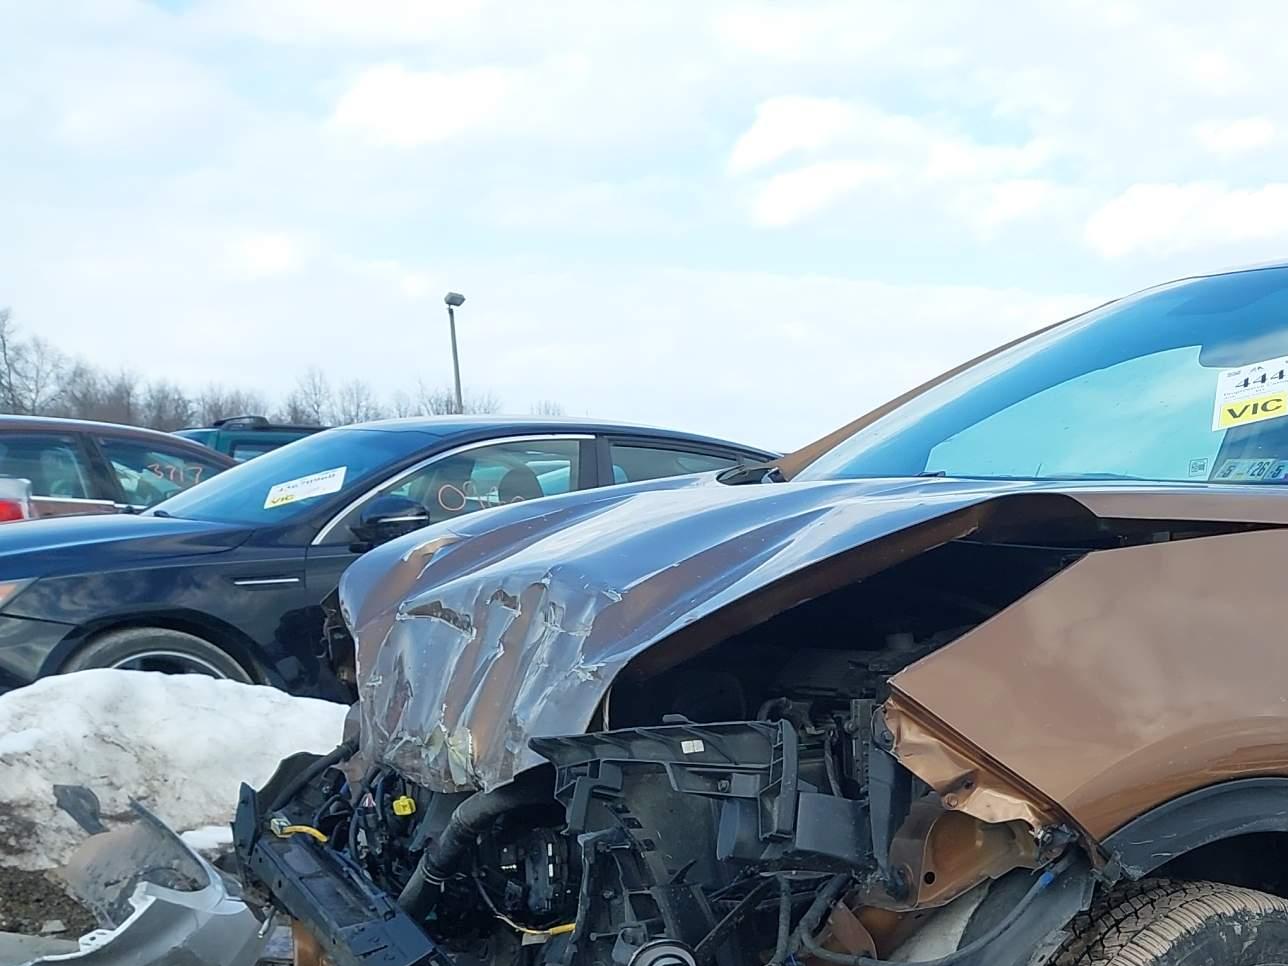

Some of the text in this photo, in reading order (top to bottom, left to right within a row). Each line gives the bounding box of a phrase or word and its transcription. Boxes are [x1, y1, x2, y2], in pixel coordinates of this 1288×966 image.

[1227, 398, 1283, 419] VIC
[147, 463, 203, 484] 3717
[1250, 461, 1271, 477] 26
